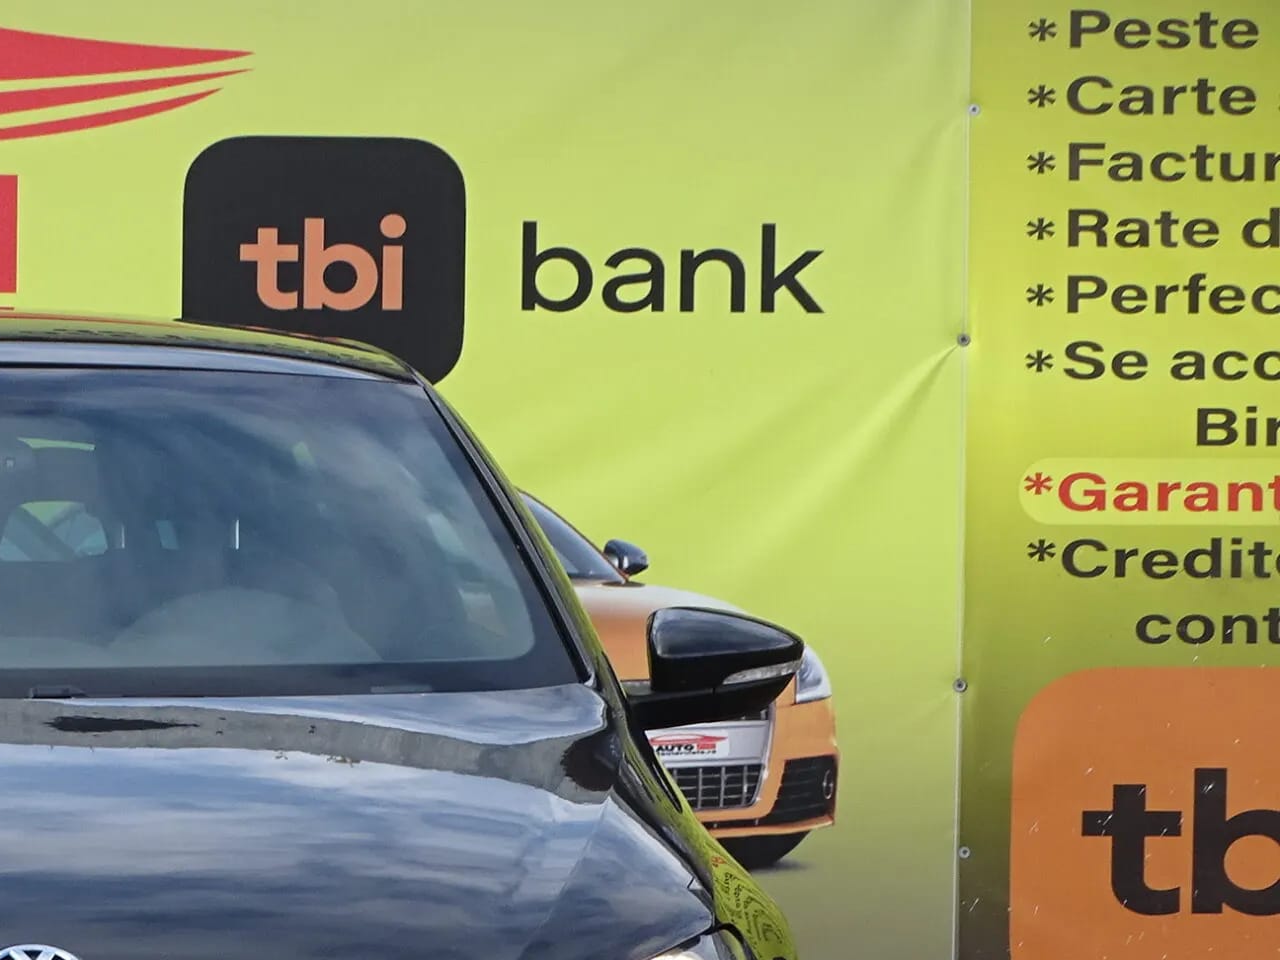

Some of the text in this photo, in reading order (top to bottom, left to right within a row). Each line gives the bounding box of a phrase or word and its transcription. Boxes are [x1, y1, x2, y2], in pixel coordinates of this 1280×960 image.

[239, 213, 824, 314] tbi bank
[1027, 537, 1280, 579] Credit
